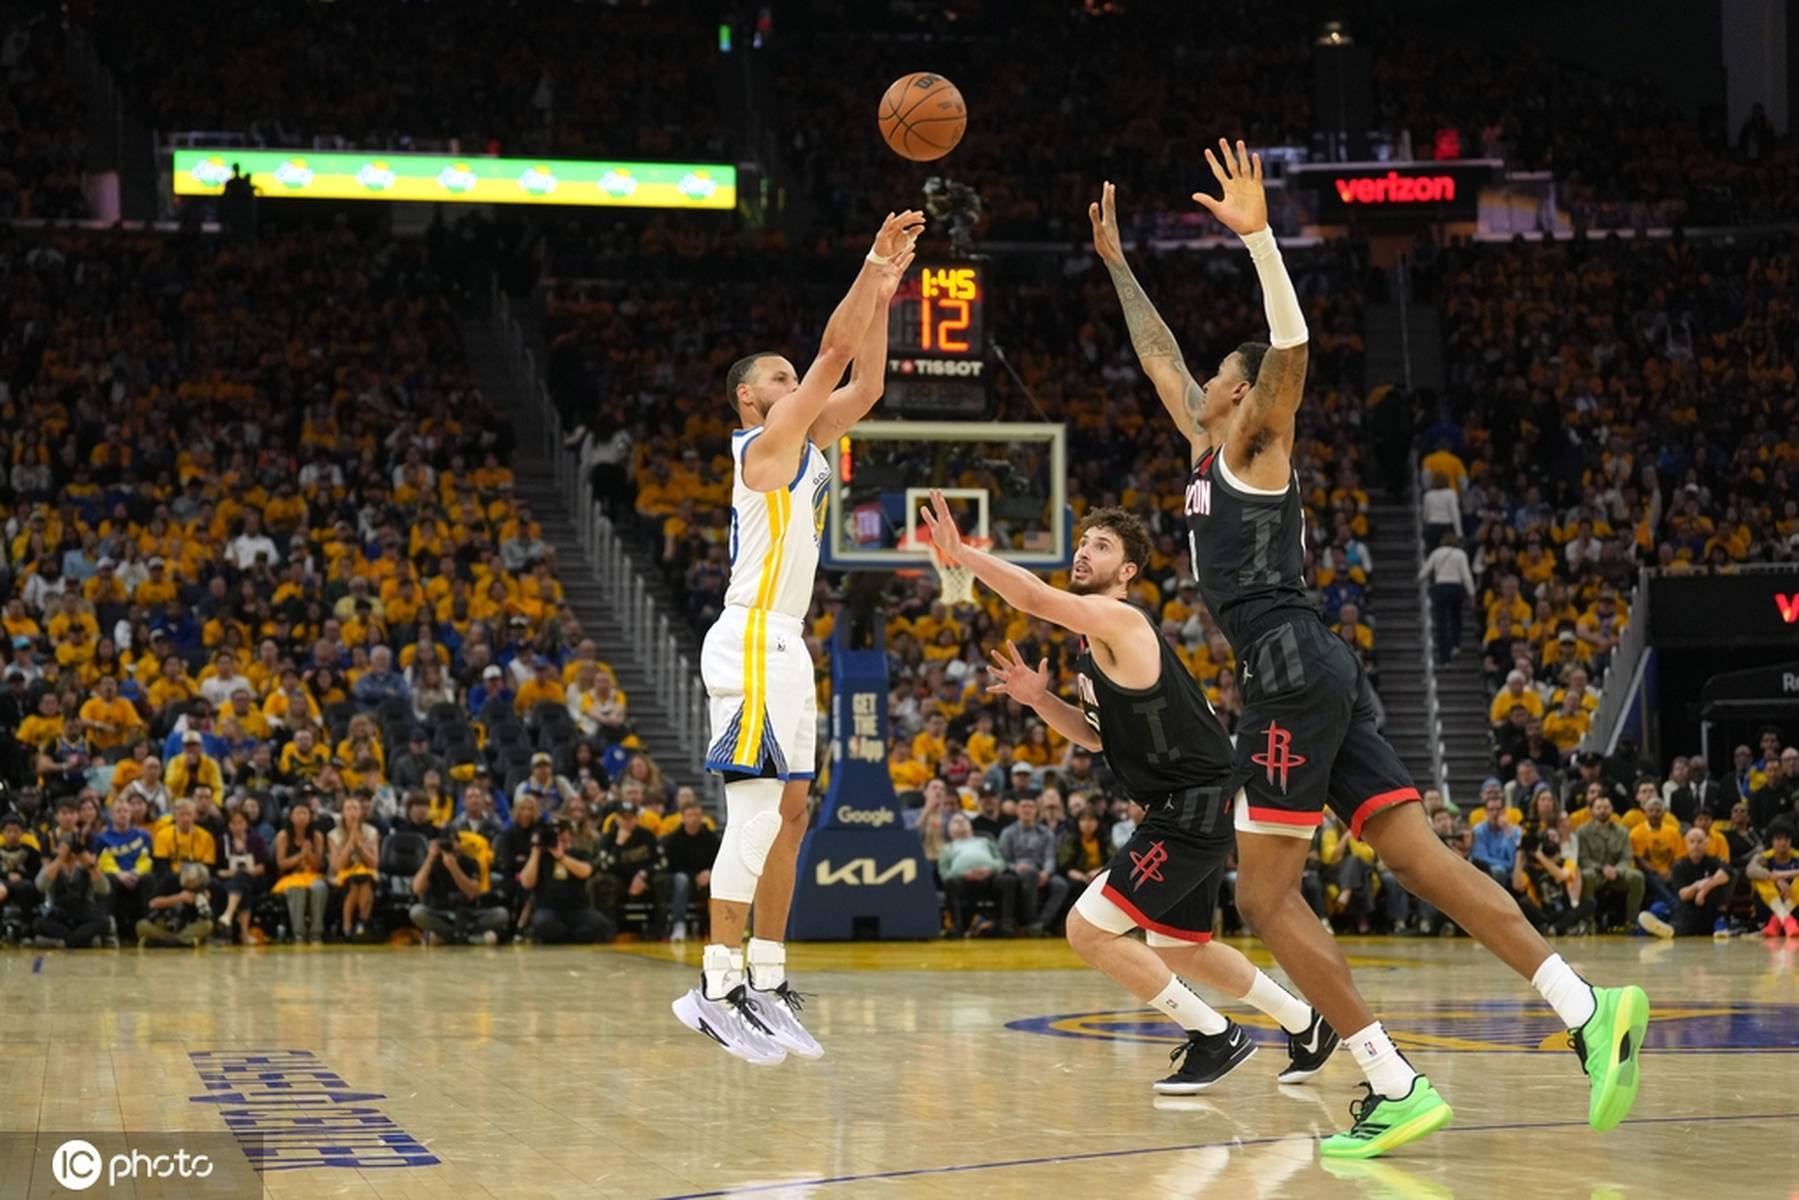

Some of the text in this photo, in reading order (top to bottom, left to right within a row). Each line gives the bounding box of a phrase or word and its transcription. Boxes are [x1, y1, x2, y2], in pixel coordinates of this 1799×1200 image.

[1336, 171, 1455, 202] verizon
[922, 268, 976, 300] 1:45
[922, 299, 969, 351] 12
[914, 360, 983, 376] TISSOT
[852, 692, 877, 714] GET
[853, 714, 878, 736] THE
[837, 805, 894, 827] Google
[219, 1108, 442, 1172] CENTER
